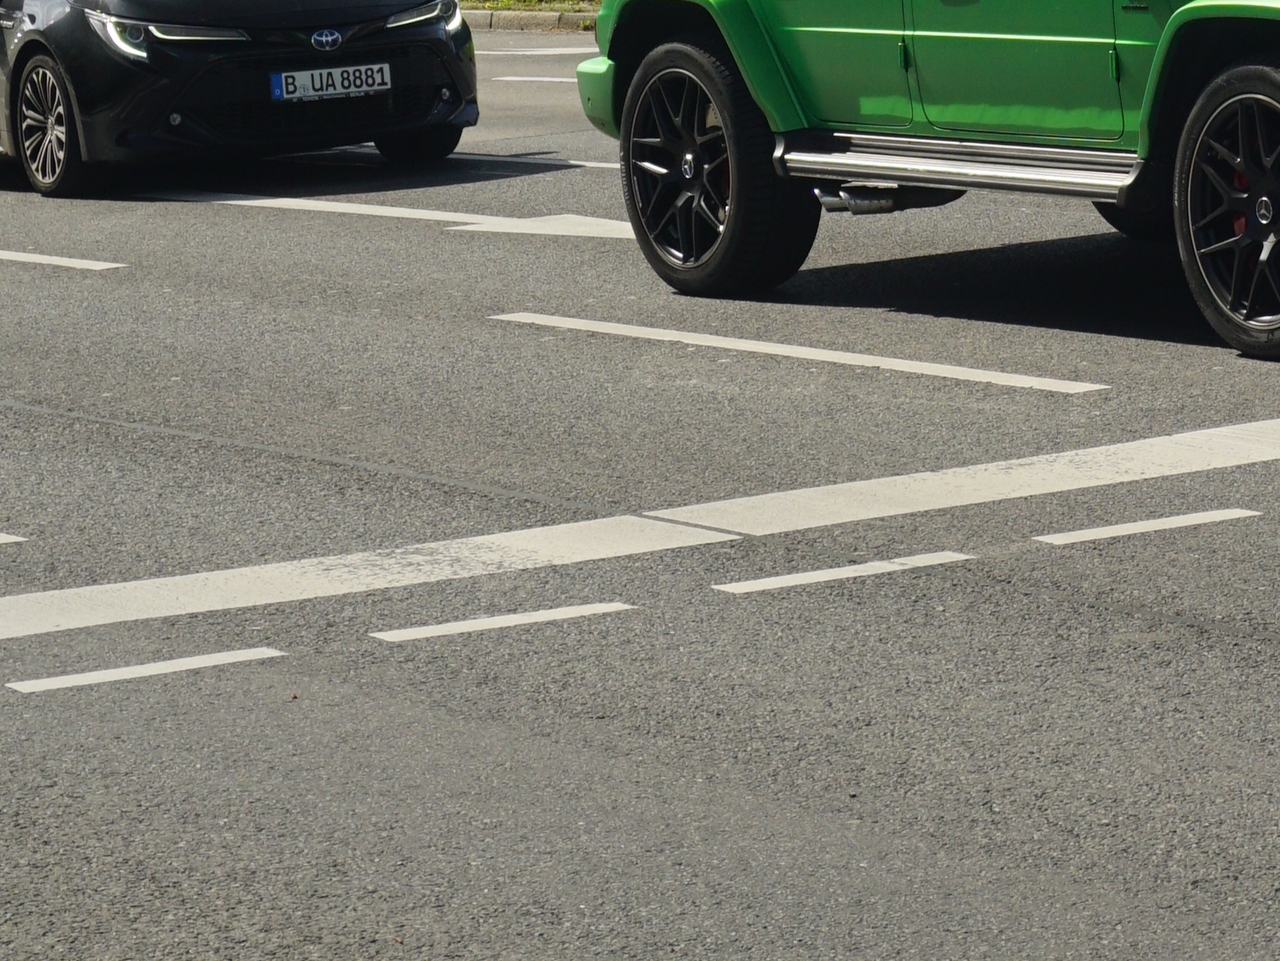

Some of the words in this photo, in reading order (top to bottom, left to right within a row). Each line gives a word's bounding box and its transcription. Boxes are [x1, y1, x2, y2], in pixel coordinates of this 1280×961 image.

[284, 75, 297, 95] B
[310, 71, 337, 92] UA
[340, 66, 388, 90] 8881
